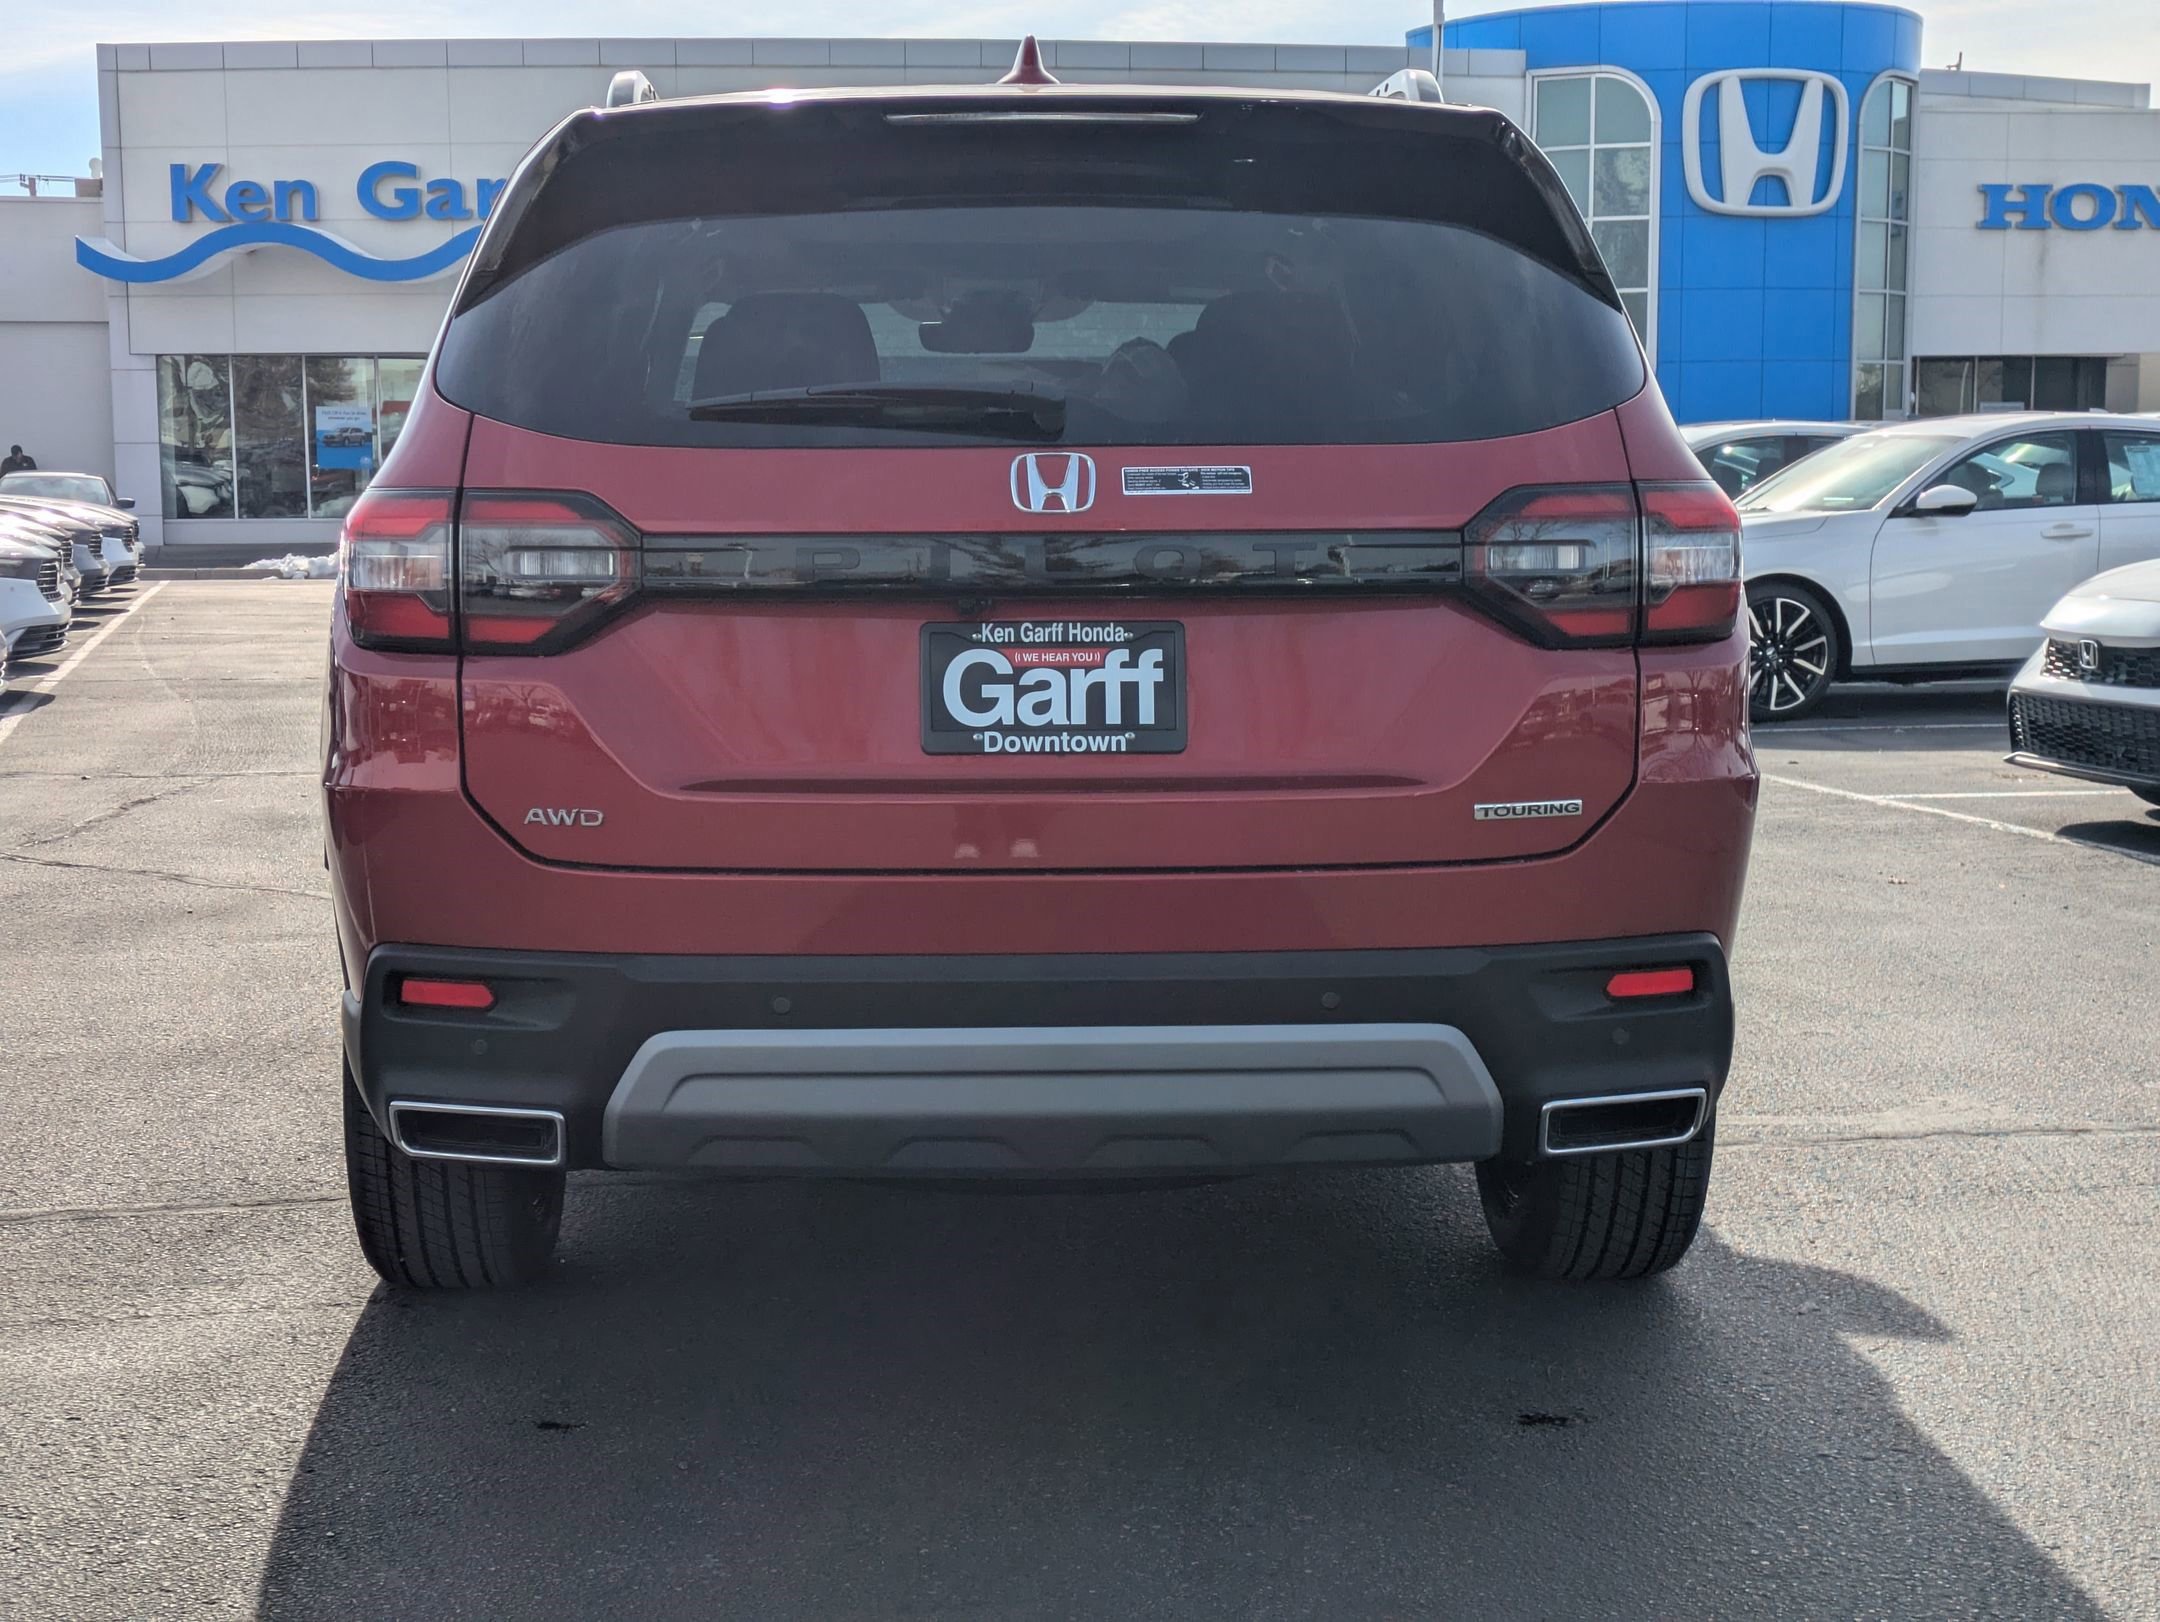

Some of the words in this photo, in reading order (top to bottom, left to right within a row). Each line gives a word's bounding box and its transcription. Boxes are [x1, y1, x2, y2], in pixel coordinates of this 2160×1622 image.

[170, 163, 319, 222] Ken
[795, 543, 1317, 582] PILOT
[981, 622, 1014, 642] Ken
[1020, 622, 1063, 642] Garff
[1068, 622, 1125, 642] Honda
[1022, 652, 1039, 662] WE
[1041, 652, 1070, 662] HEAR
[1071, 652, 1093, 662] YOU
[943, 648, 1164, 727] Garff
[983, 731, 1127, 753] Downtown
[523, 808, 604, 827] AWD
[1477, 802, 1580, 818] TOURING
